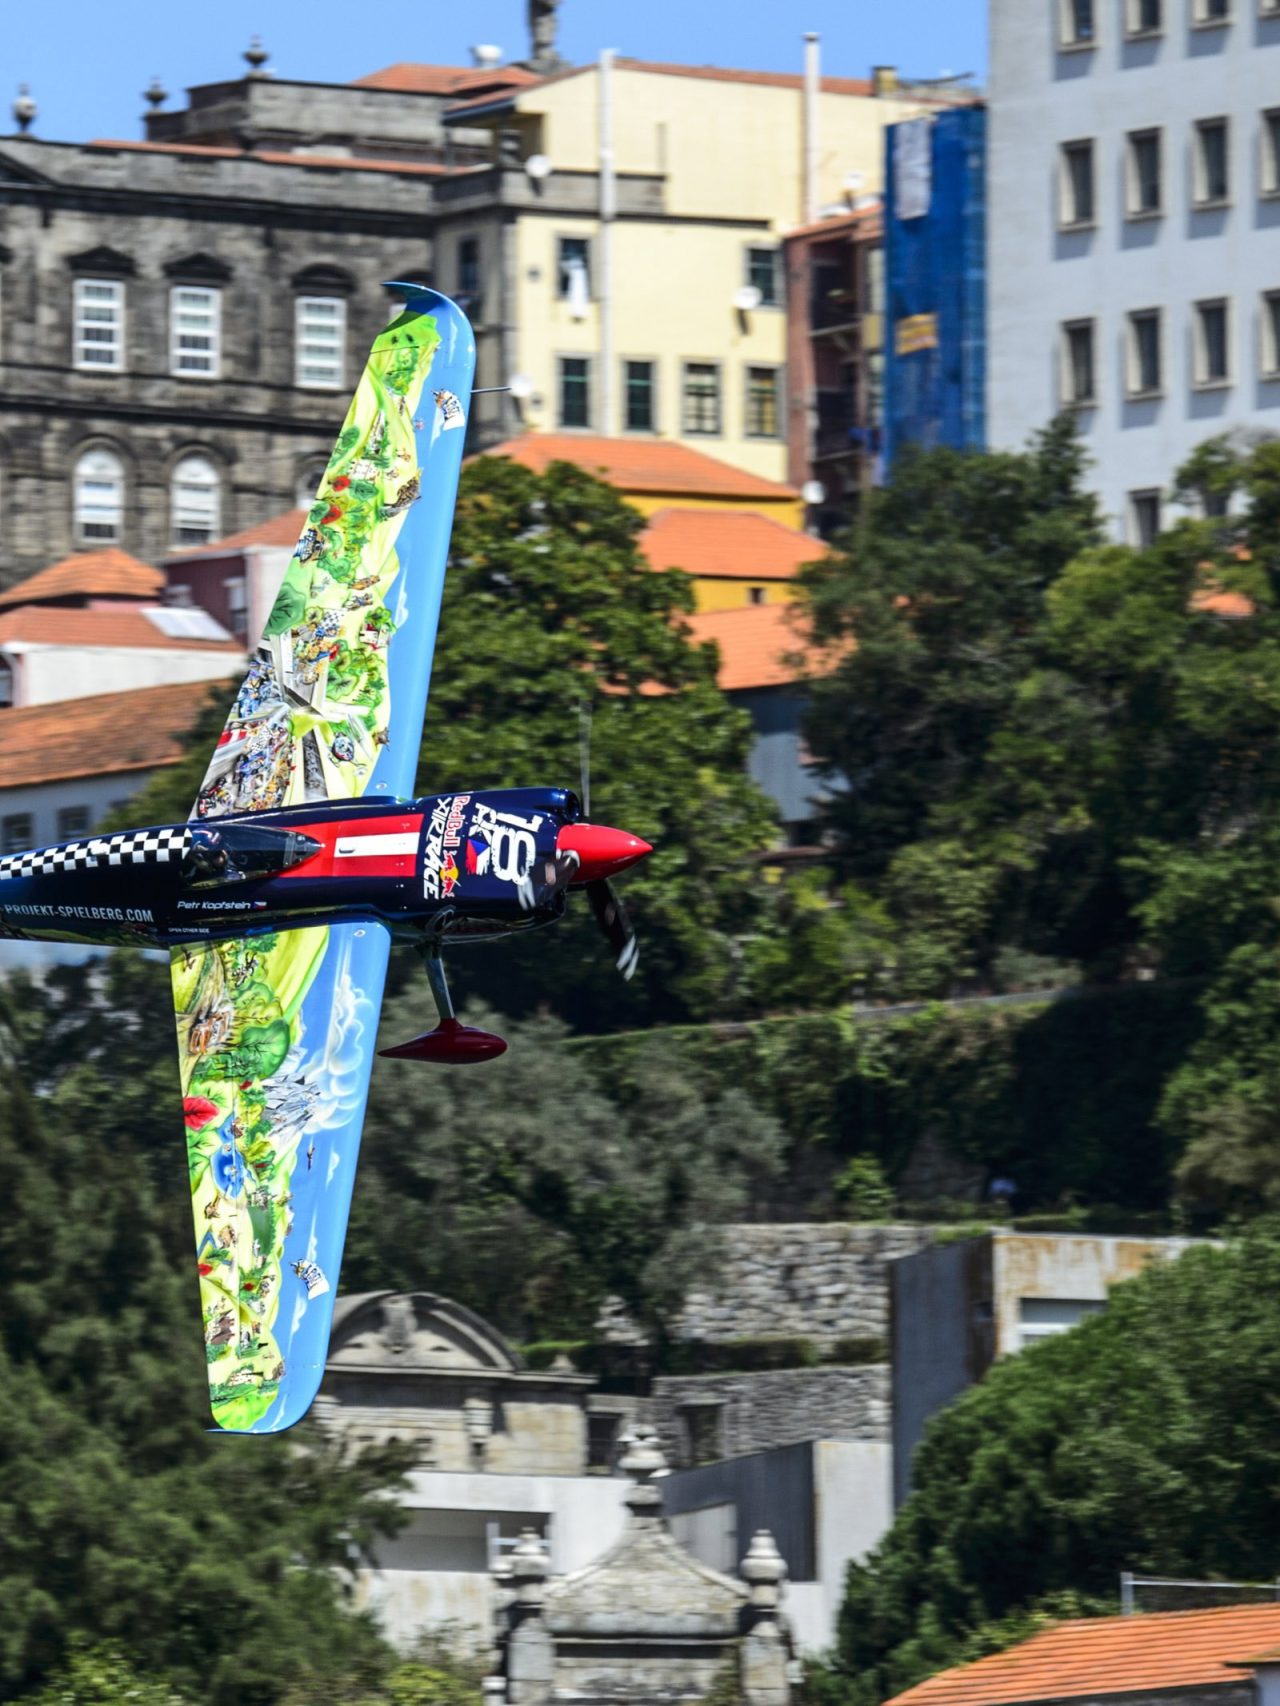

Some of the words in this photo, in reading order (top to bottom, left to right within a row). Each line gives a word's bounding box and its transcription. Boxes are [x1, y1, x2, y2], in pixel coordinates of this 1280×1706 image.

[450, 795, 471, 819] Red
[443, 819, 464, 847] Bull
[491, 812, 544, 886] 18
[3, 904, 154, 923] PROJEKT-SPIELBERG.COM
[176, 901, 200, 909] Petr
[202, 901, 251, 910] Kopfstein
